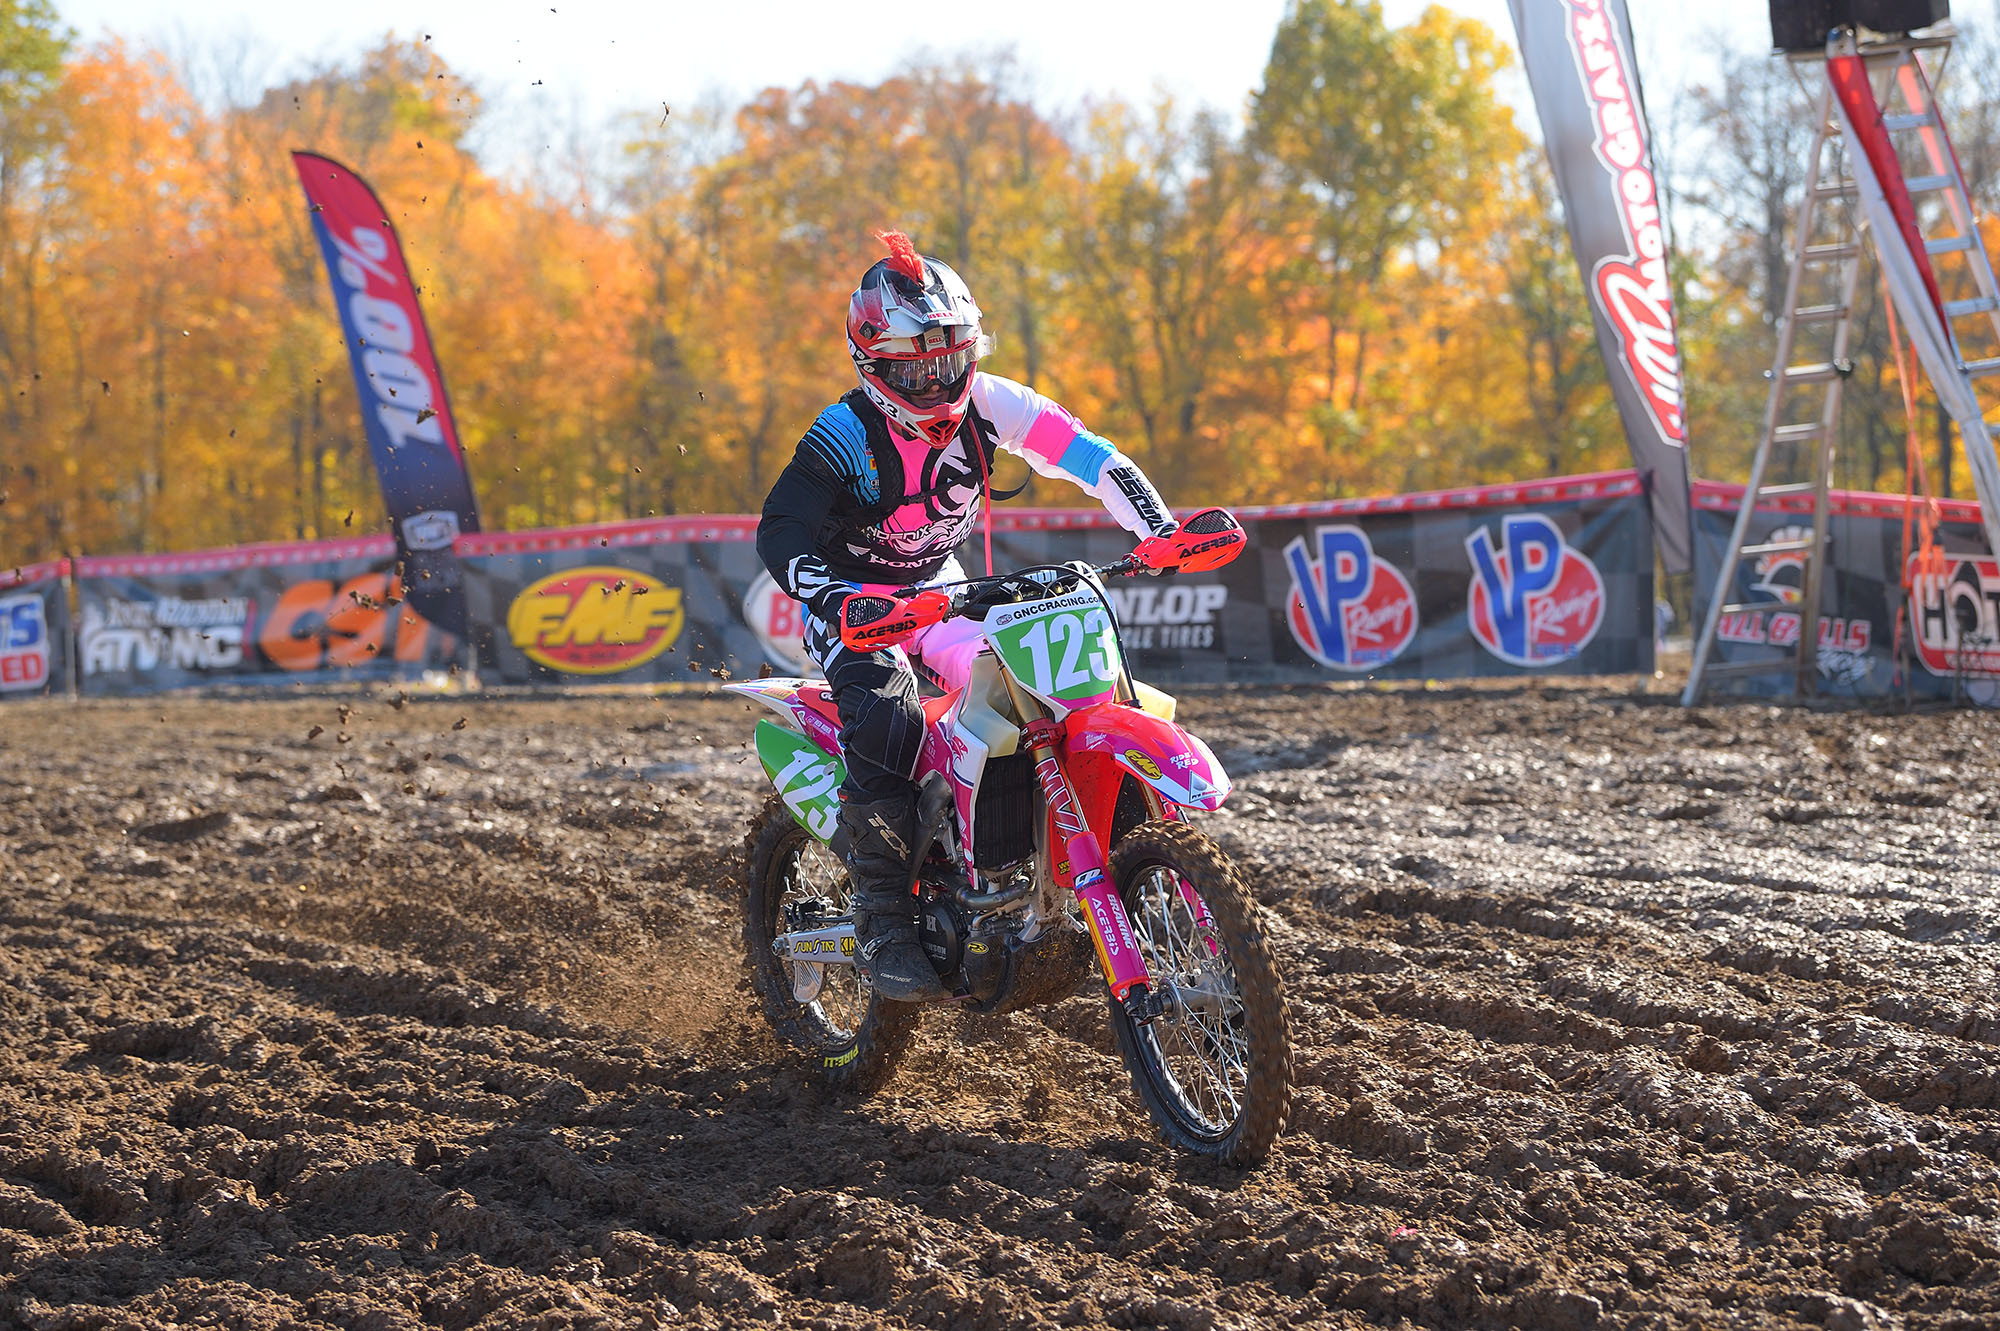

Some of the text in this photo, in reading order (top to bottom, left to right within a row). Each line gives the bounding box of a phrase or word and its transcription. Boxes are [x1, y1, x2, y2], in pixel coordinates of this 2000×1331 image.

[330, 225, 443, 448] 100%
[512, 580, 681, 647] FMF
[1013, 596, 1099, 620] GNCCRACING.co
[1112, 585, 1228, 625] NLOP
[1289, 532, 1371, 664] VP
[1472, 521, 1560, 658] VP
[1019, 612, 1119, 696] 123
[1161, 624, 1214, 648] TIRES
[1768, 613, 1871, 651] BLLS
[1125, 751, 1162, 778] FMF
[1177, 757, 1200, 770] RED
[773, 749, 843, 840] 123
[1106, 893, 1134, 950] BRAKING
